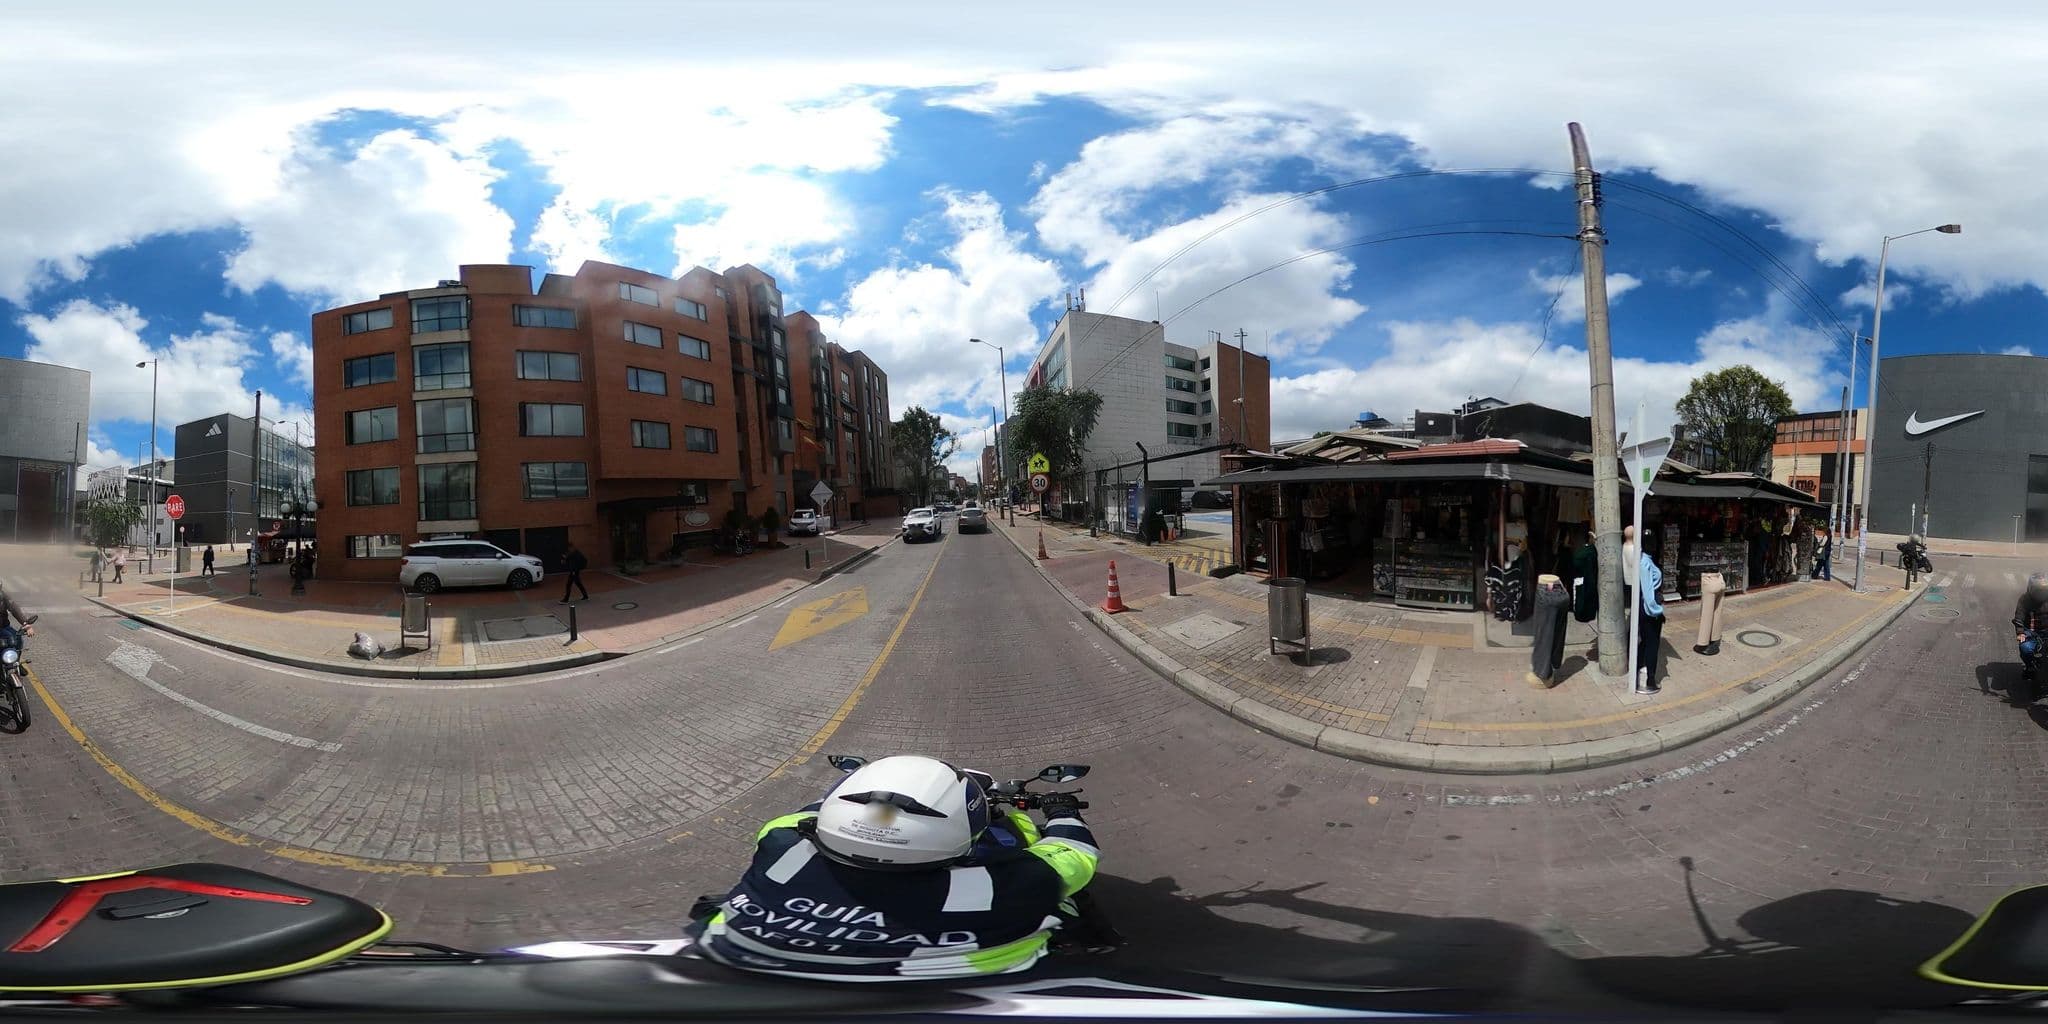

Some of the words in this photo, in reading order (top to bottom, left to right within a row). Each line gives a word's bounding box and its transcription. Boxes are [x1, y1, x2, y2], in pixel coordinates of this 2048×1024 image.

[1034, 478, 1046, 487] 30
[168, 503, 182, 512] PARE
[731, 894, 978, 946] MOVILIDAD
[784, 897, 886, 928] GUÍA
